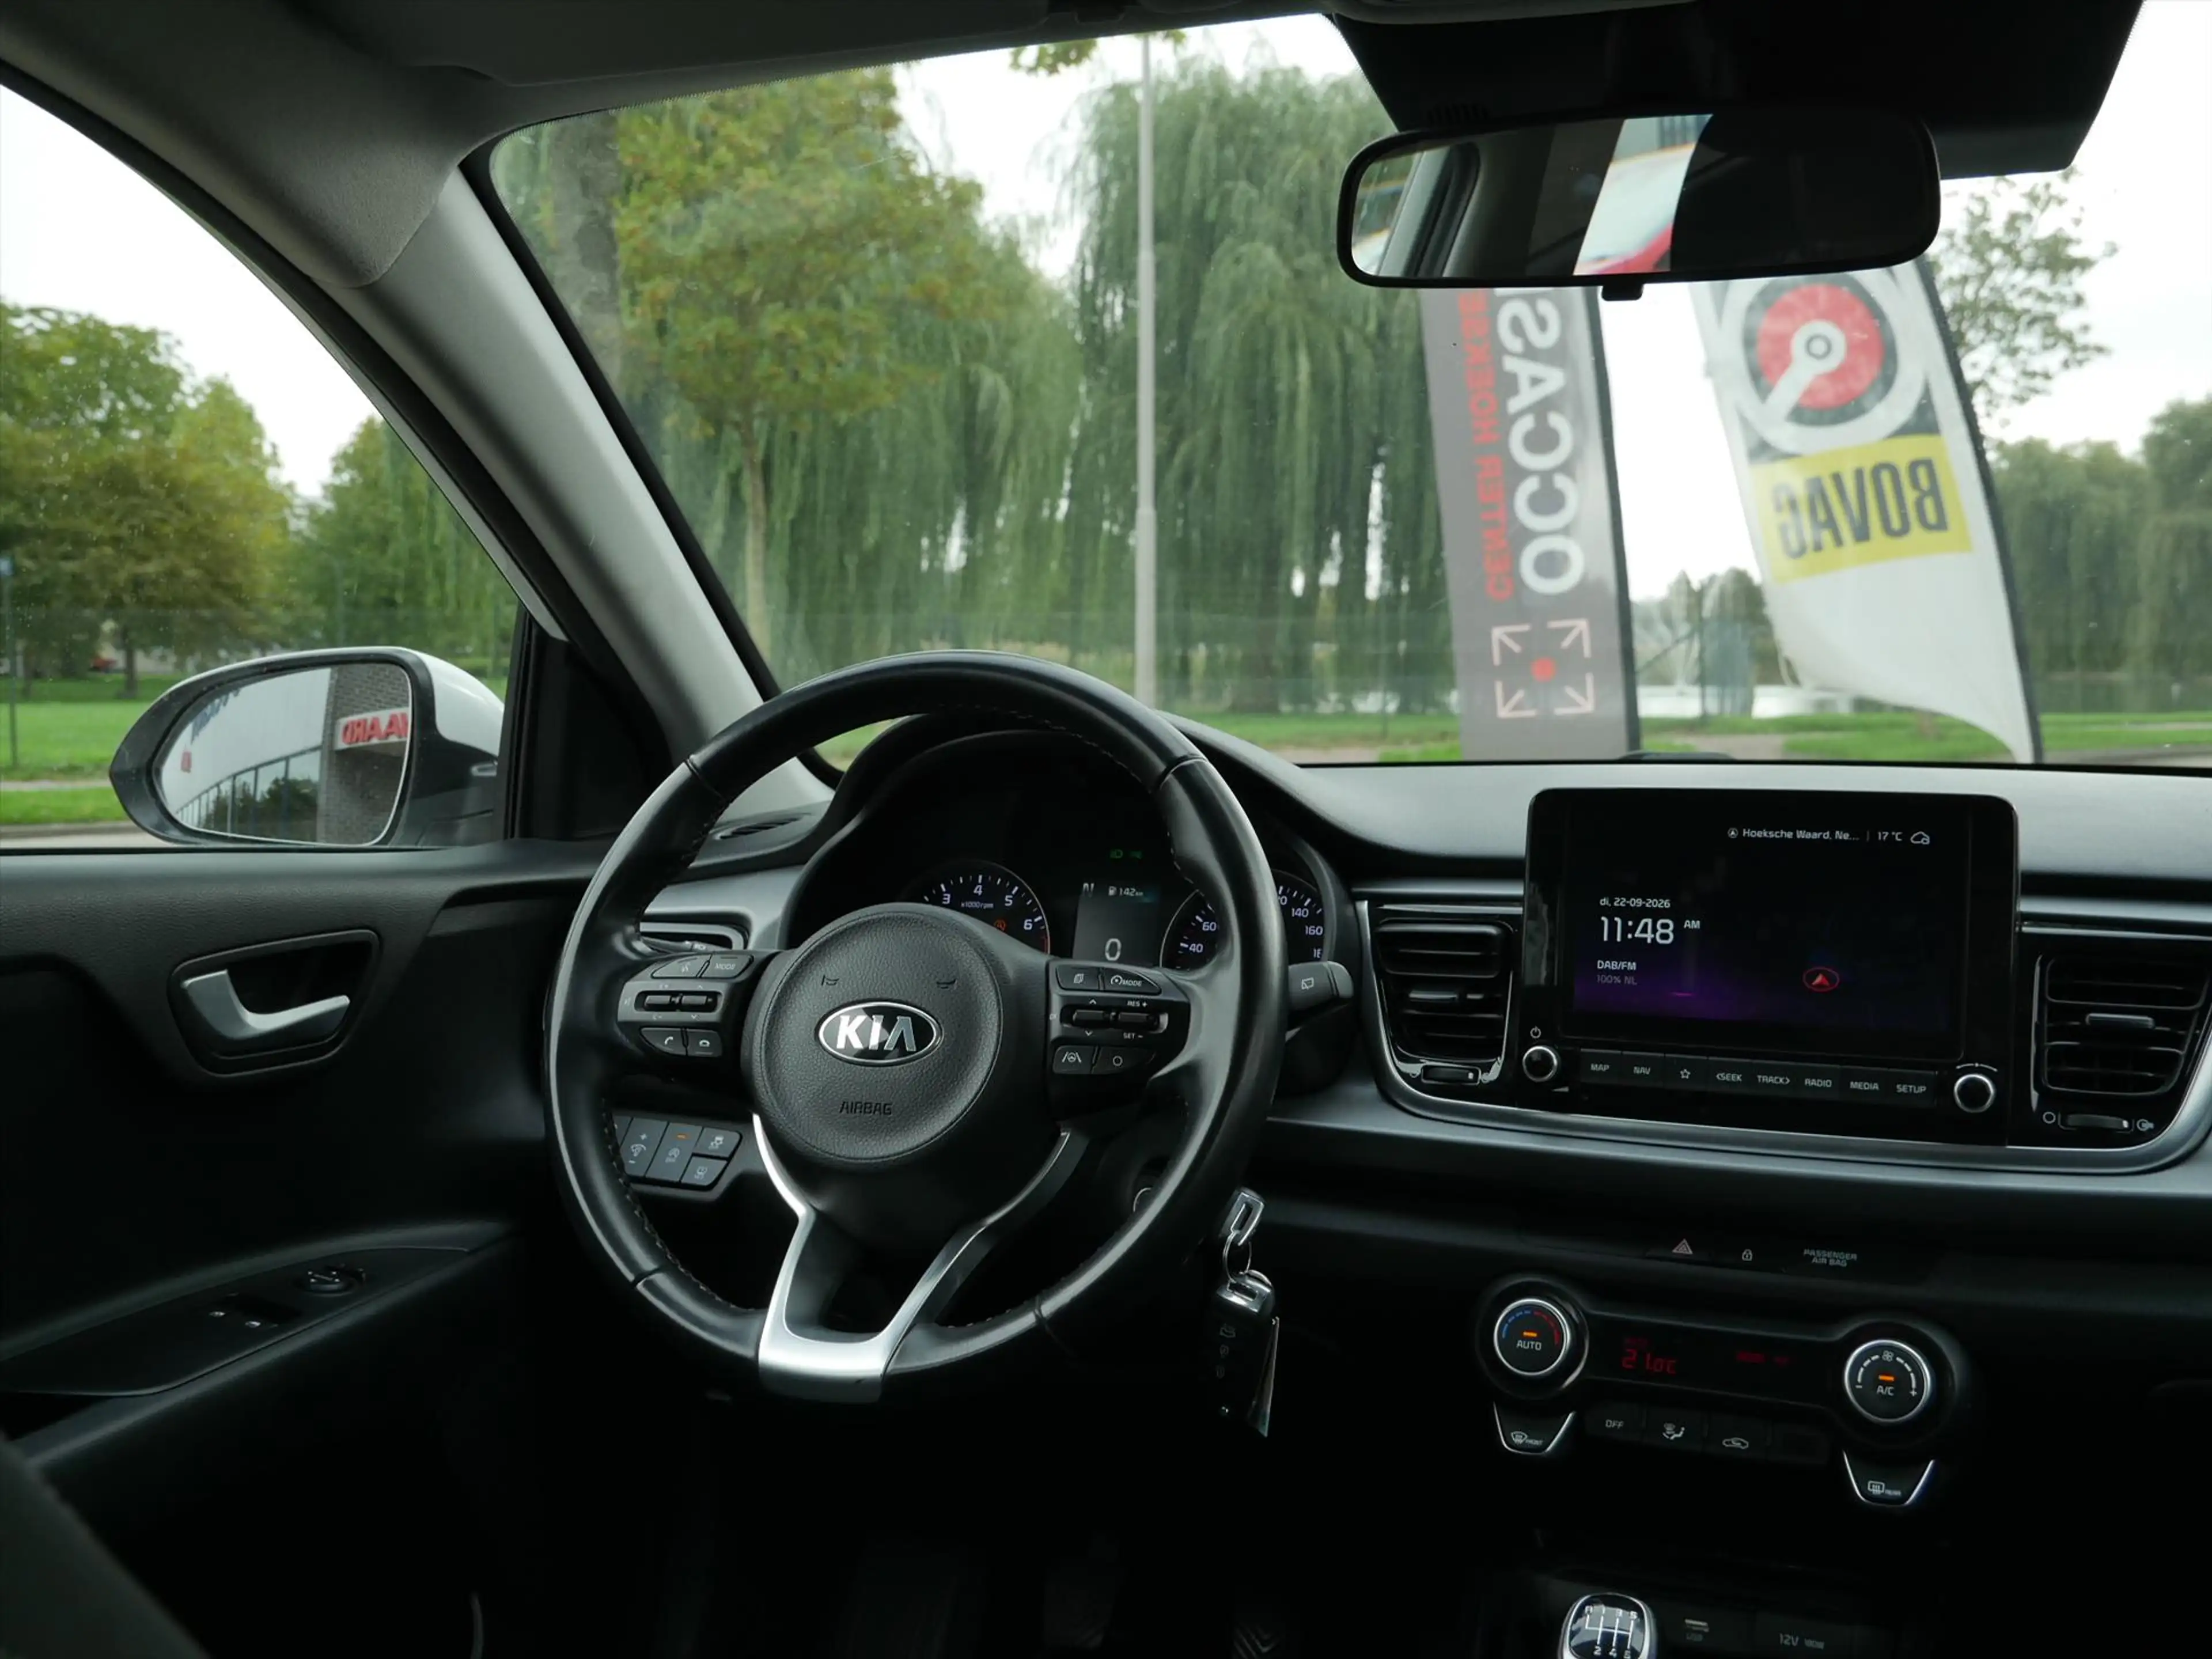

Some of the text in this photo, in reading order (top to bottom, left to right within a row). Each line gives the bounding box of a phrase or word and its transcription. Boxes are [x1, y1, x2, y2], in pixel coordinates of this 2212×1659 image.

[1743, 829, 1793, 839] Hoeksche
[1878, 831, 1887, 840] 17
[974, 884, 983, 895] 4
[942, 893, 950, 904] 3
[1005, 895, 1013, 907] 5
[1599, 897, 1671, 908] di, 22-09-2026
[1291, 908, 1309, 918] 140
[1023, 919, 1033, 930] 6
[1202, 922, 1217, 931] 60
[1305, 925, 1324, 935] 160
[1601, 916, 1700, 945] 11:48 AM
[1105, 938, 1122, 961] 0
[1189, 943, 1203, 953] 40
[1597, 960, 1637, 971] DAB/FM
[836, 1014, 917, 1052] KIA
[1590, 1064, 1609, 1072] MAP
[1634, 1066, 1651, 1075] NAV
[1805, 1078, 1832, 1088] RADIO
[1850, 1081, 1879, 1090] MEDIA
[1896, 1084, 1926, 1094] SETUP
[839, 1101, 893, 1115] AIRBAG
[1517, 1340, 1542, 1351] AUTO
[1876, 1385, 1895, 1396] A/C
[1605, 1419, 1624, 1429] OFF
[1779, 1633, 1799, 1646] 12V
[1593, 1645, 1601, 1656] 2
